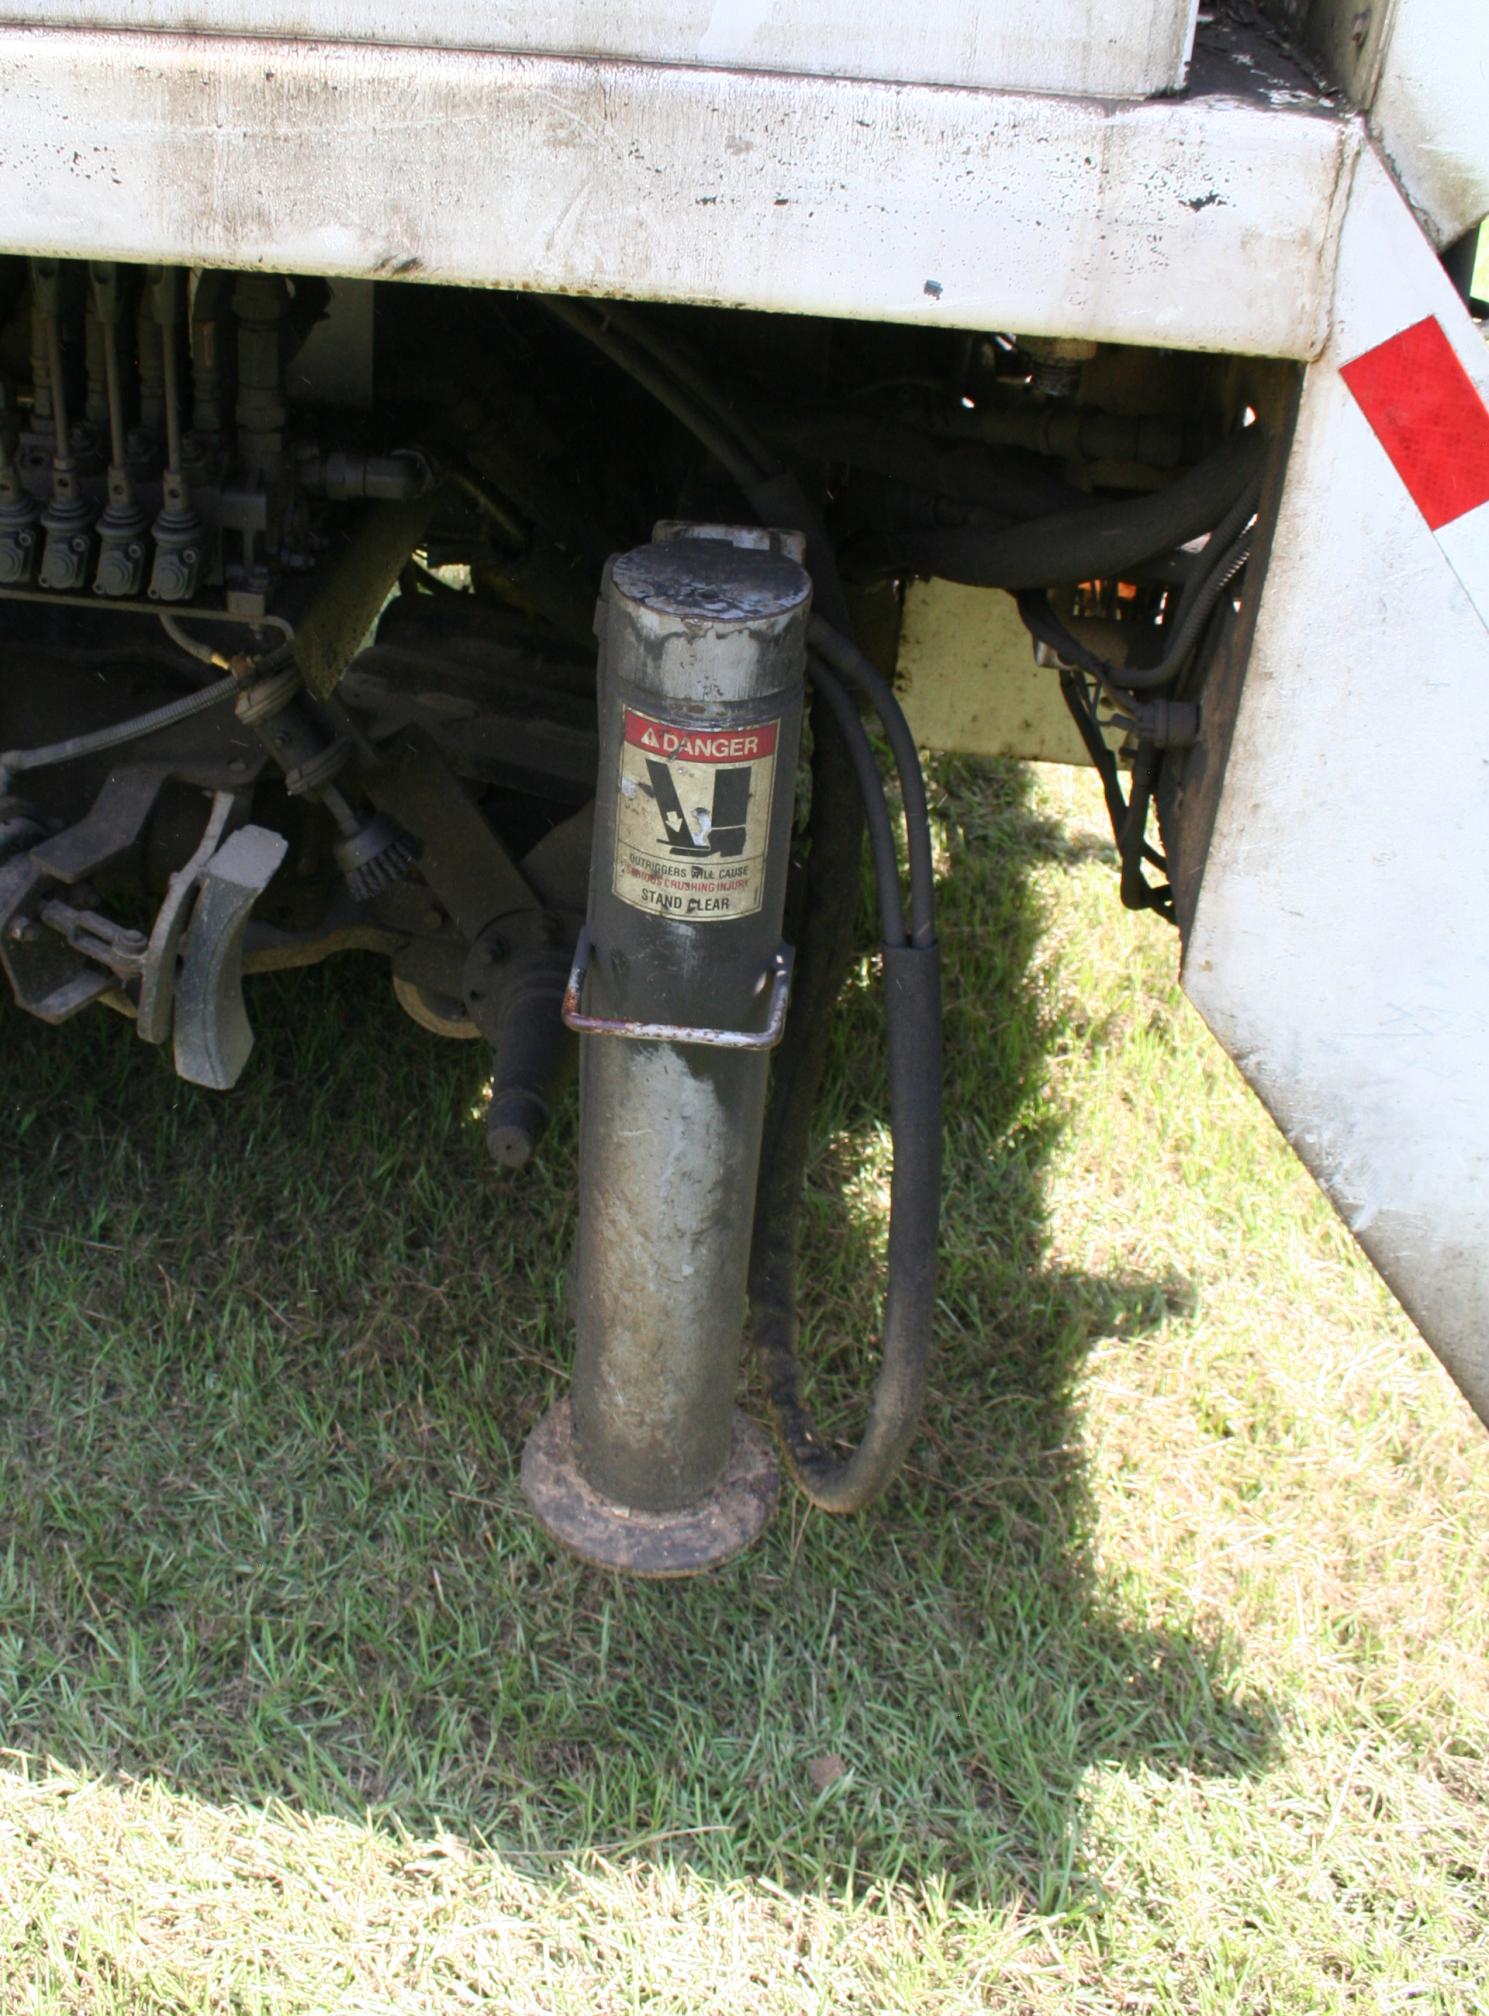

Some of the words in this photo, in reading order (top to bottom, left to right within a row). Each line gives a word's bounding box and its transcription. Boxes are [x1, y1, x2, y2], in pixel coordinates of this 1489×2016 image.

[663, 733, 759, 757] DANGER
[629, 853, 687, 878] OUTRIGGERS
[719, 866, 749, 879] CAUSE
[664, 879, 715, 893] CRUSHING
[641, 888, 682, 910] STAND
[686, 897, 729, 913] CLEAR
